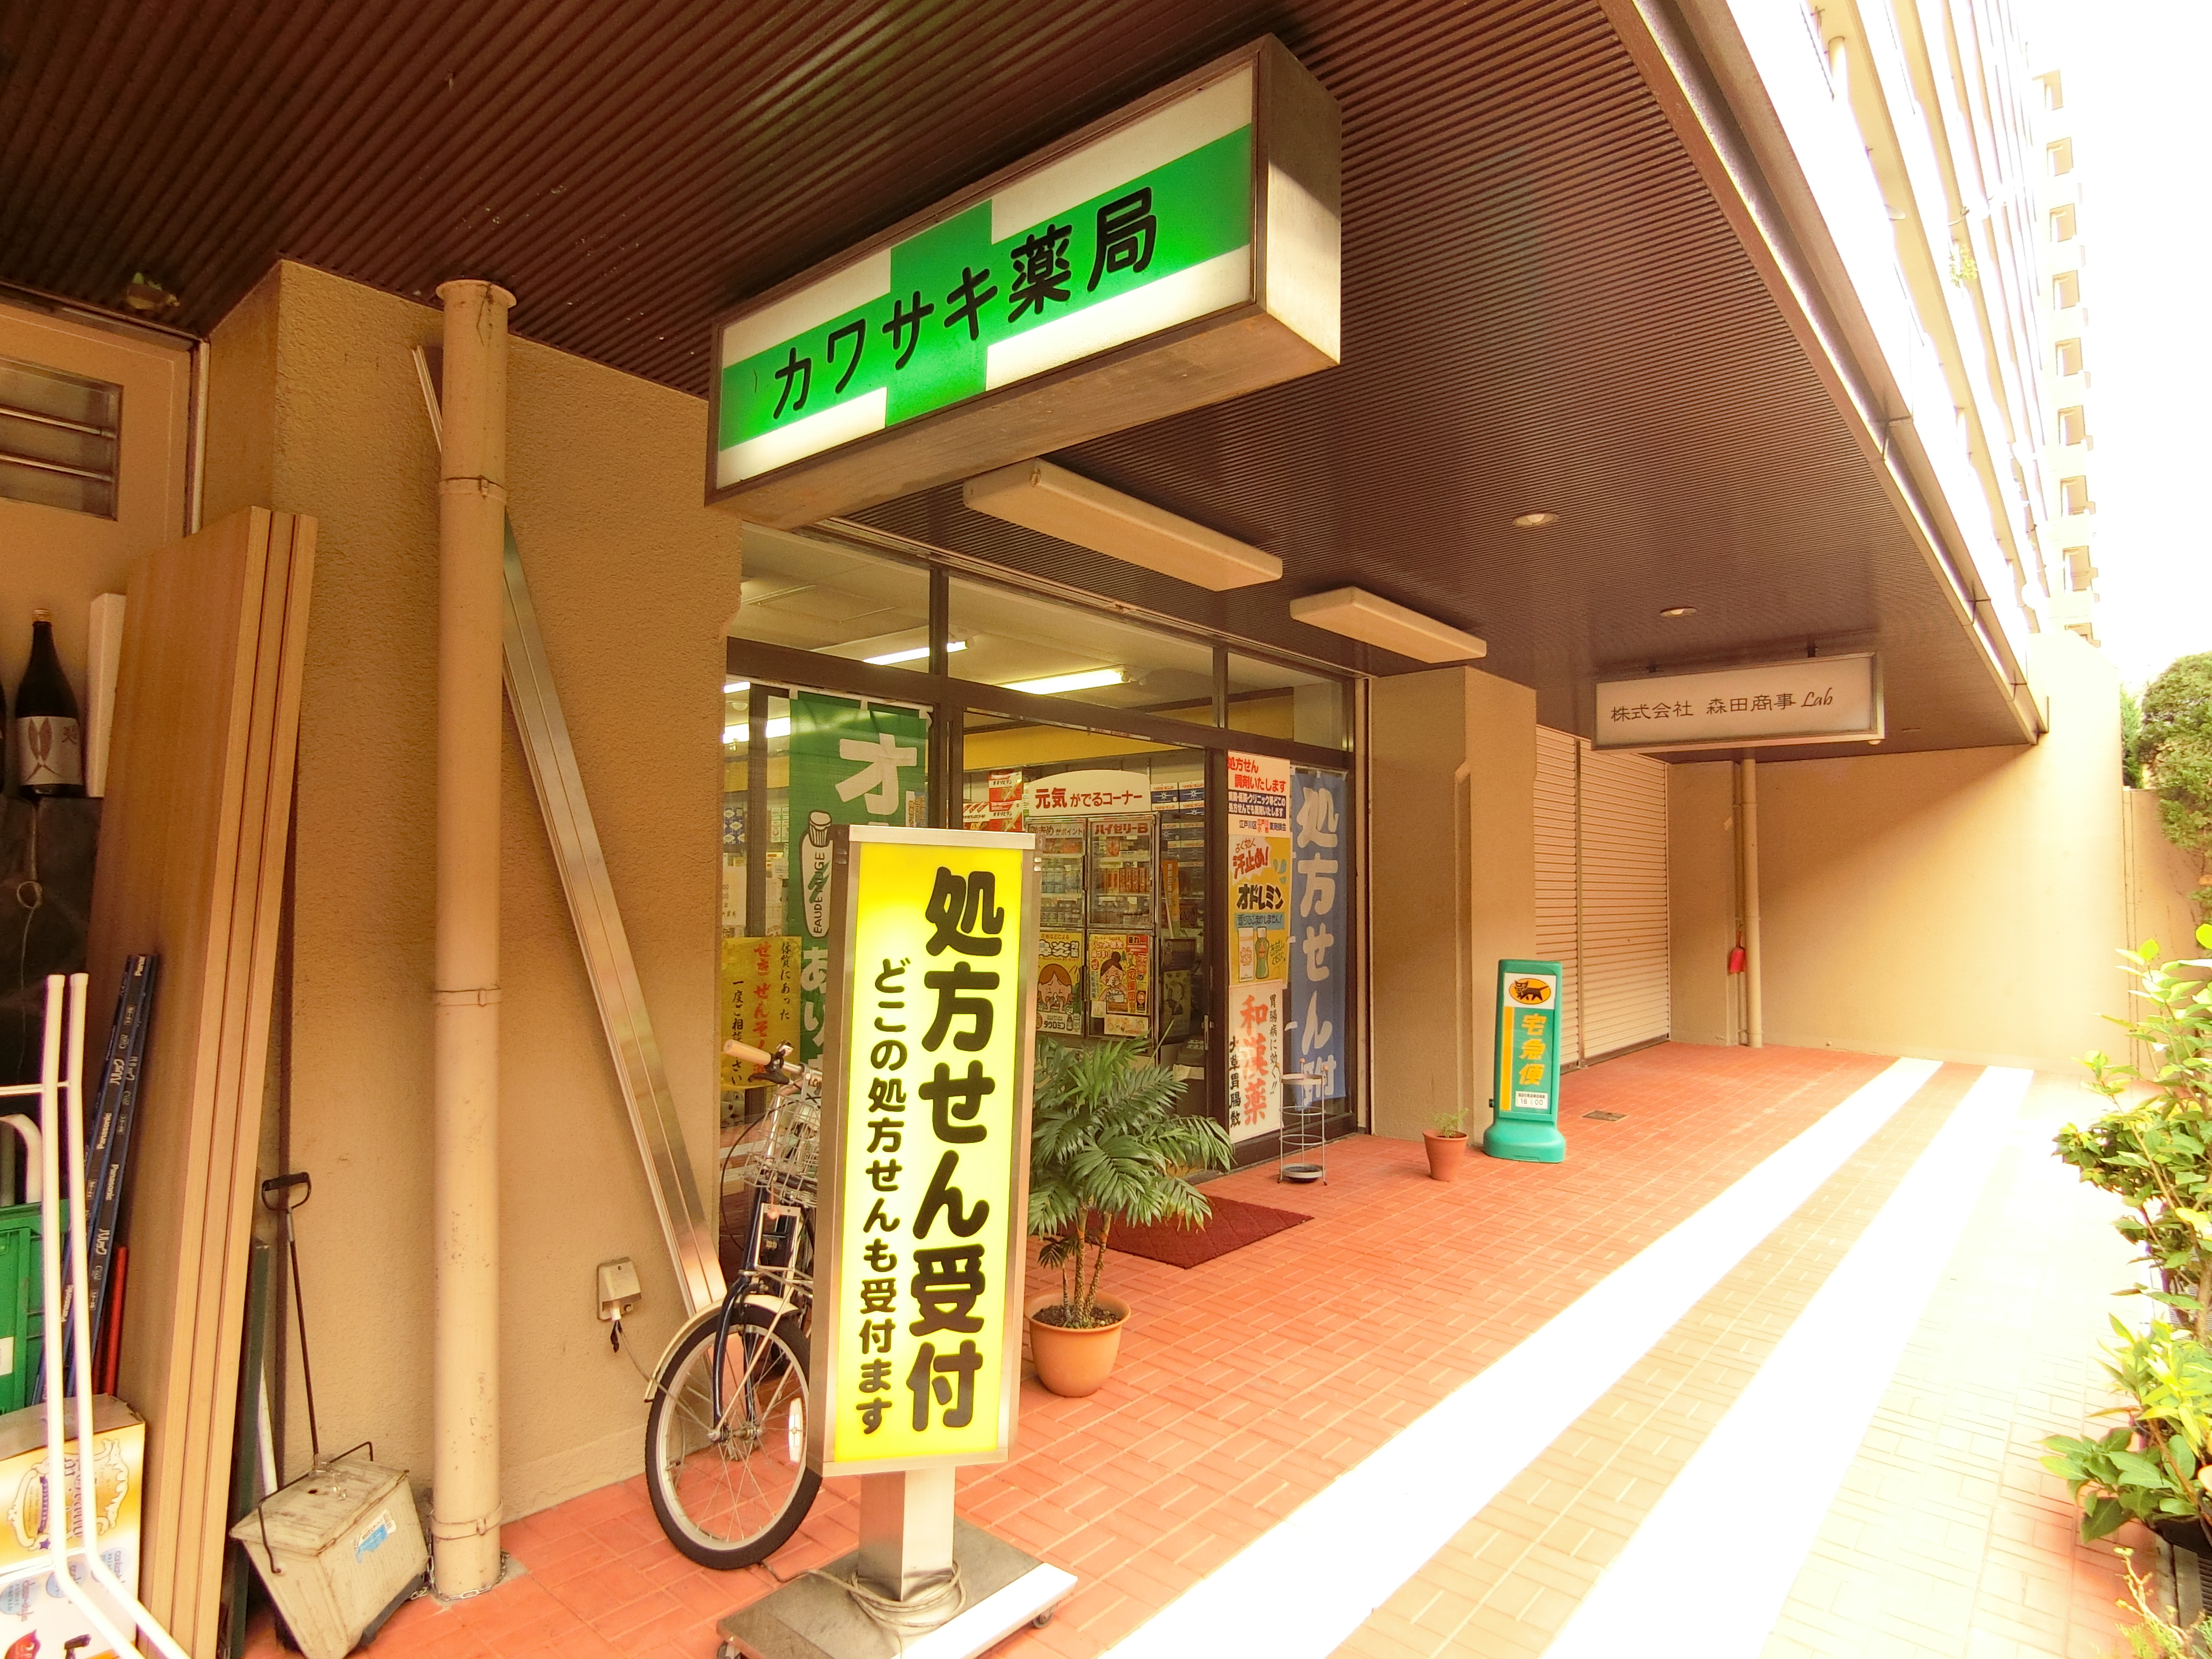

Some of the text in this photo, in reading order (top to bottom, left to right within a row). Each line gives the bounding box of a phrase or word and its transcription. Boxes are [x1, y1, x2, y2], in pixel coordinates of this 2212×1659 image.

[773, 186, 1157, 420] カワサキ薬局
[1611, 687, 1833, 722] 株式会社 森田商事 Lab
[1228, 756, 1259, 773] 処方せん
[1235, 774, 1286, 792] 調剤いたします
[1035, 787, 1142, 808] 元気がでるコーナー
[1236, 884, 1284, 910] オドレミン
[1240, 995, 1269, 1126] 和漢薬
[1519, 1013, 1547, 1086] 宅急便
[97, 1112, 112, 1150] Panasonic
[909, 866, 1005, 1432] 処方せん受付
[105, 1163, 120, 1201] Panasonic
[858, 958, 910, 1434] どこの処方せんも受付ます
